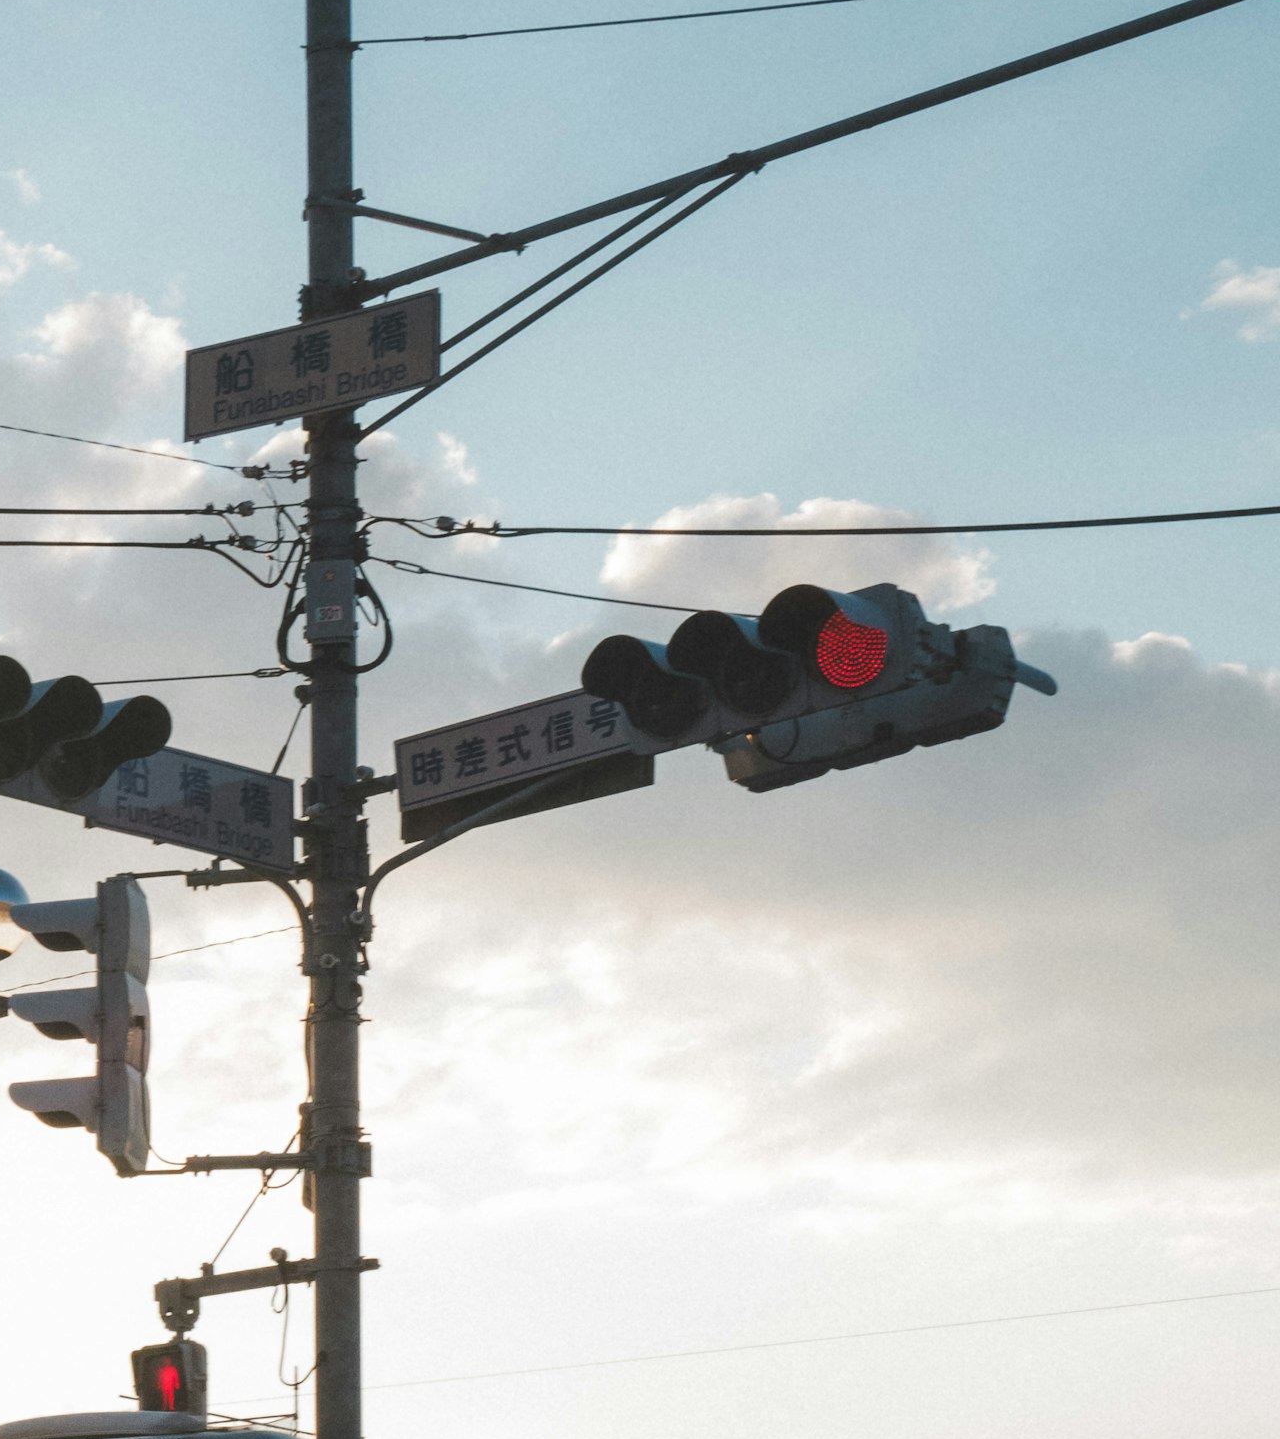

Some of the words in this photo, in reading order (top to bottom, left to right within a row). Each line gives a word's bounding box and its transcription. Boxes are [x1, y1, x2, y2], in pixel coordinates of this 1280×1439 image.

[214, 310, 409, 397] 船橋橋
[213, 378, 327, 424] Funabashi
[336, 362, 408, 397] Bridge
[411, 698, 622, 788] 時差式信号
[115, 796, 209, 842] Funabashi
[216, 821, 274, 859] Bridge
